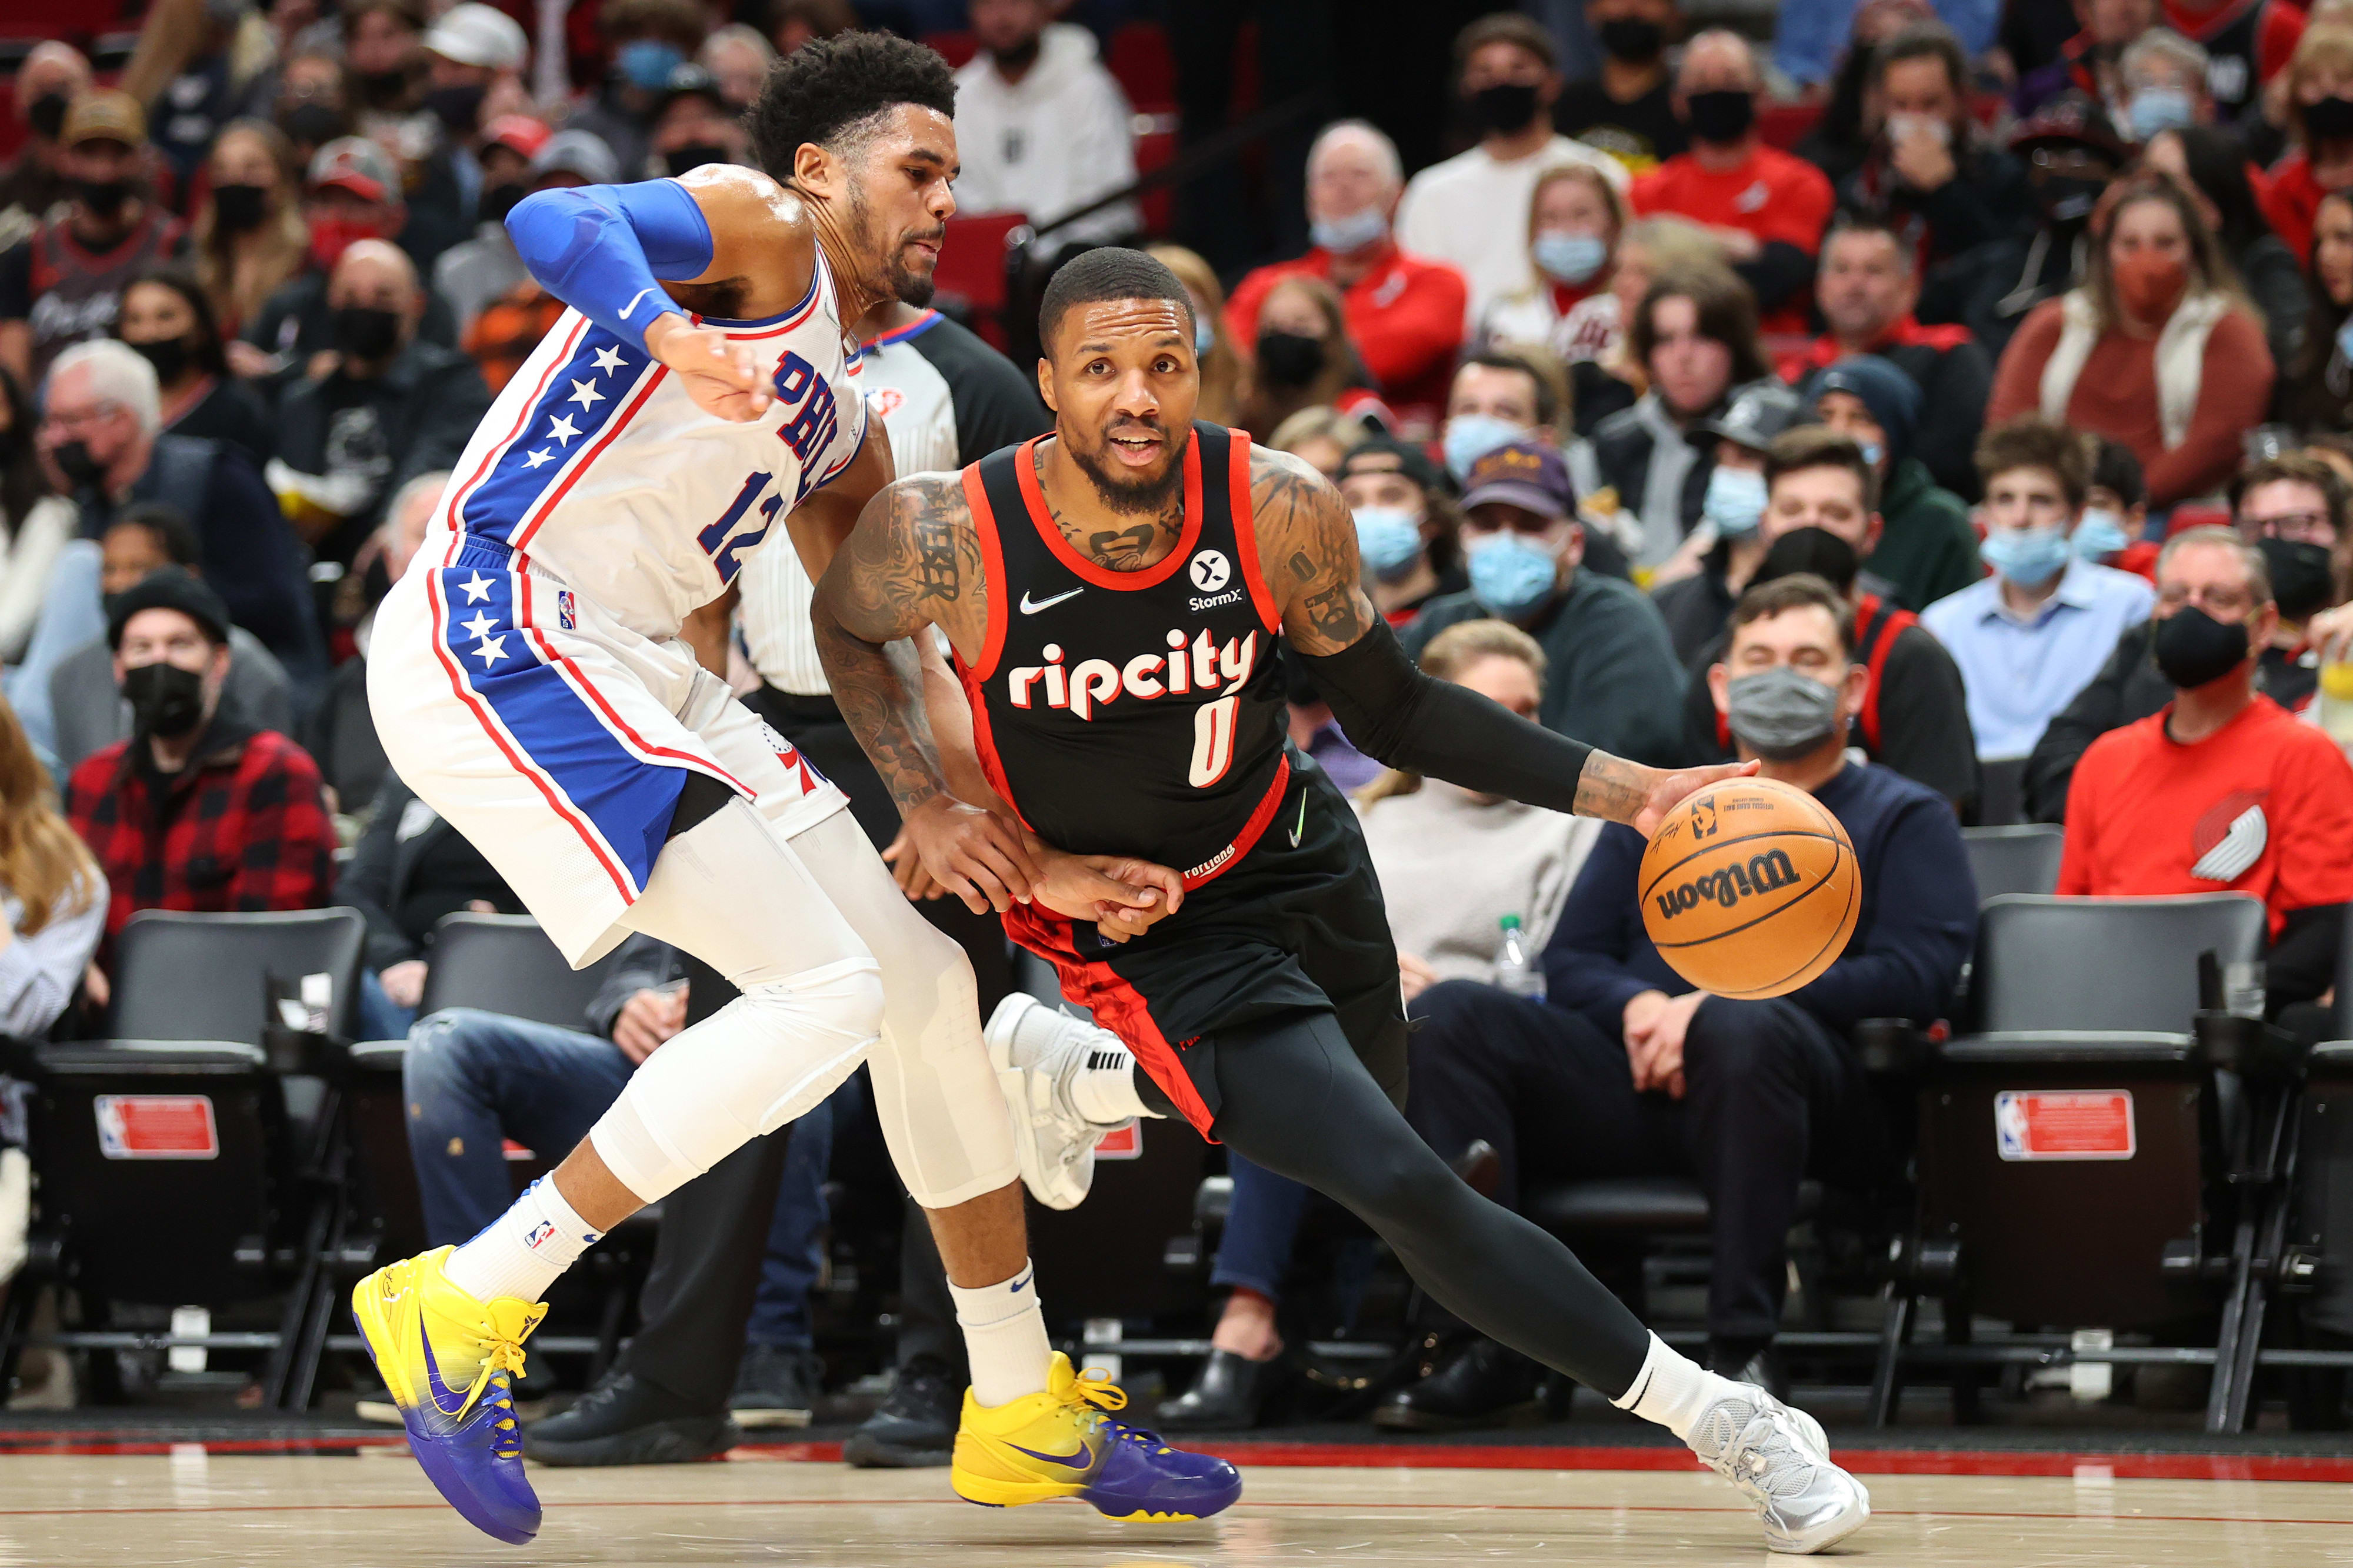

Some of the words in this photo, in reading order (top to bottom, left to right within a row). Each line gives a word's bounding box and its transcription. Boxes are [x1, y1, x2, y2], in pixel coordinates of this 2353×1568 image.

[772, 351, 838, 509] PHIL
[697, 471, 784, 586] 12
[1189, 589, 1242, 611] StormX
[1008, 628, 1257, 722] ripcity
[1188, 696, 1239, 788] 0
[1656, 848, 1801, 919] Wilson
